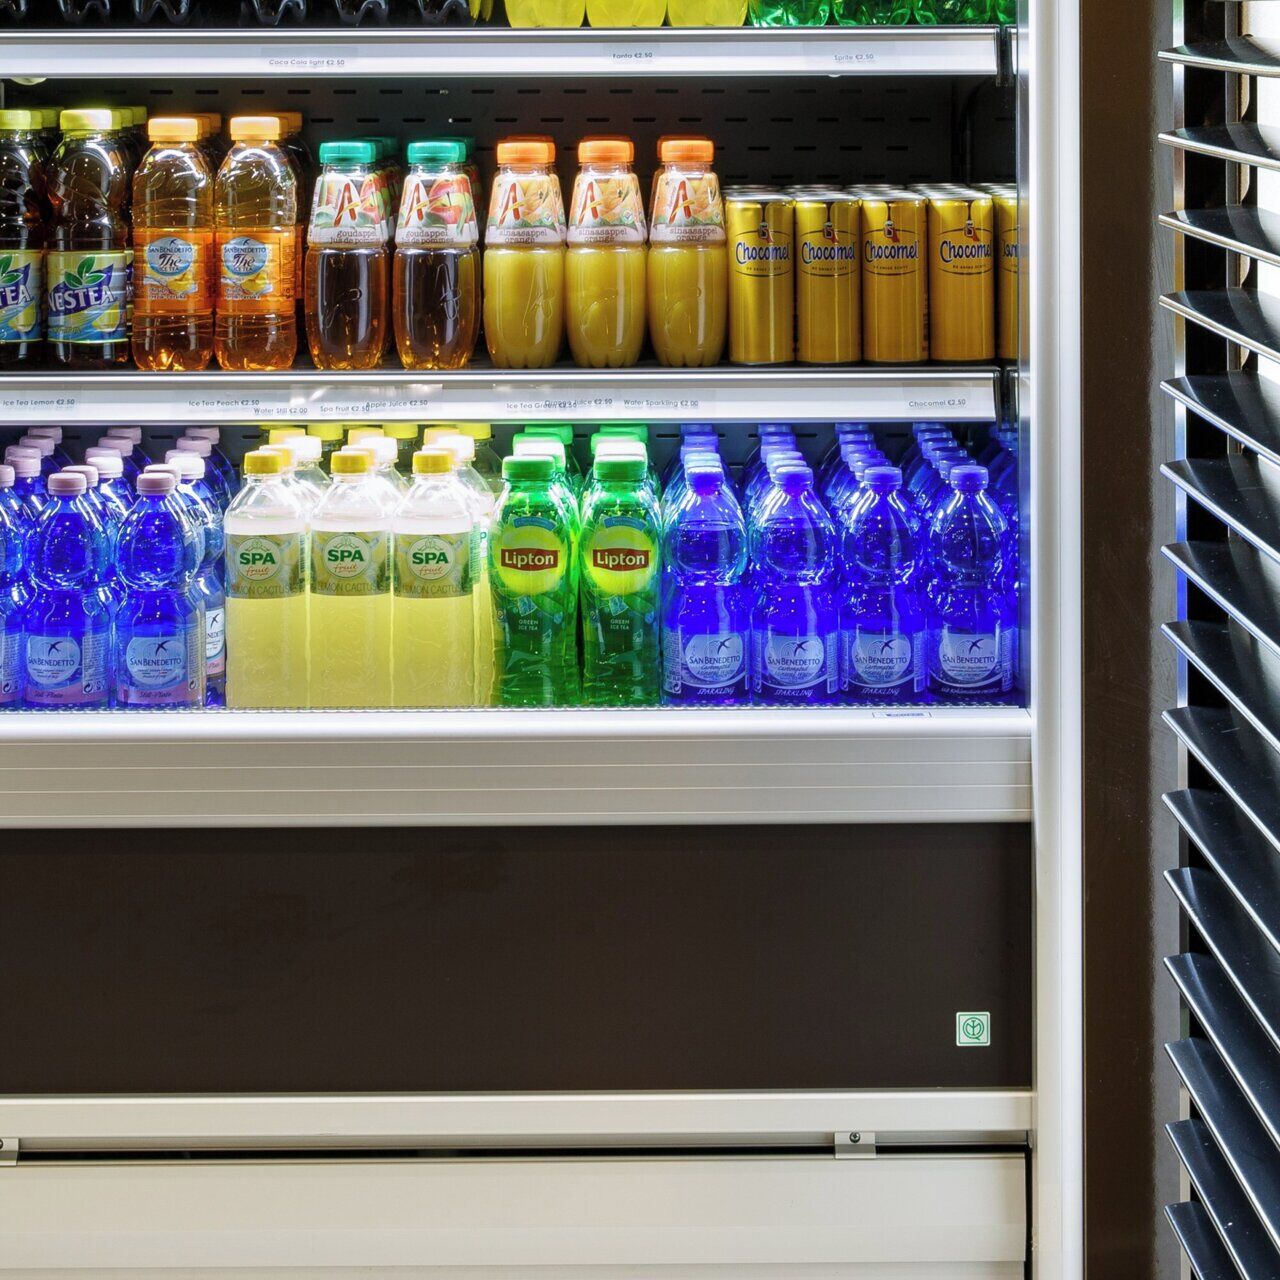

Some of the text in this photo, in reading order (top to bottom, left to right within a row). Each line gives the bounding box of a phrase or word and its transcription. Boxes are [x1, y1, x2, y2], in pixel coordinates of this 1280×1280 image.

[309, 59, 325, 67] light
[337, 229, 377, 238] goudappel
[406, 229, 448, 238] goudappel
[500, 228, 548, 238] sinaasappel
[578, 228, 628, 236] sinaasappel
[670, 227, 718, 236] sinaasappel
[504, 236, 536, 244] orange
[584, 235, 616, 243] orange
[676, 234, 708, 243] orange
[735, 241, 791, 265] Chocomel
[801, 241, 855, 265] Chocomel
[864, 240, 919, 264] Chocomel
[939, 240, 992, 263] Chocomel
[47, 285, 117, 312] NESTEA
[646, 399, 679, 407] Sparkling
[239, 552, 277, 565] SPA
[327, 549, 365, 562] SPA
[412, 551, 449, 564] SPA
[505, 551, 554, 568] Lipton
[597, 551, 645, 568] Lipton
[246, 564, 268, 576] fruit
[334, 563, 358, 574] fruit
[419, 564, 443, 576] fruit
[257, 583, 290, 594] CACTUS
[697, 687, 735, 695] SPARKLING
[774, 688, 814, 697] SPARKLING
[861, 687, 900, 695] SPARKLING
